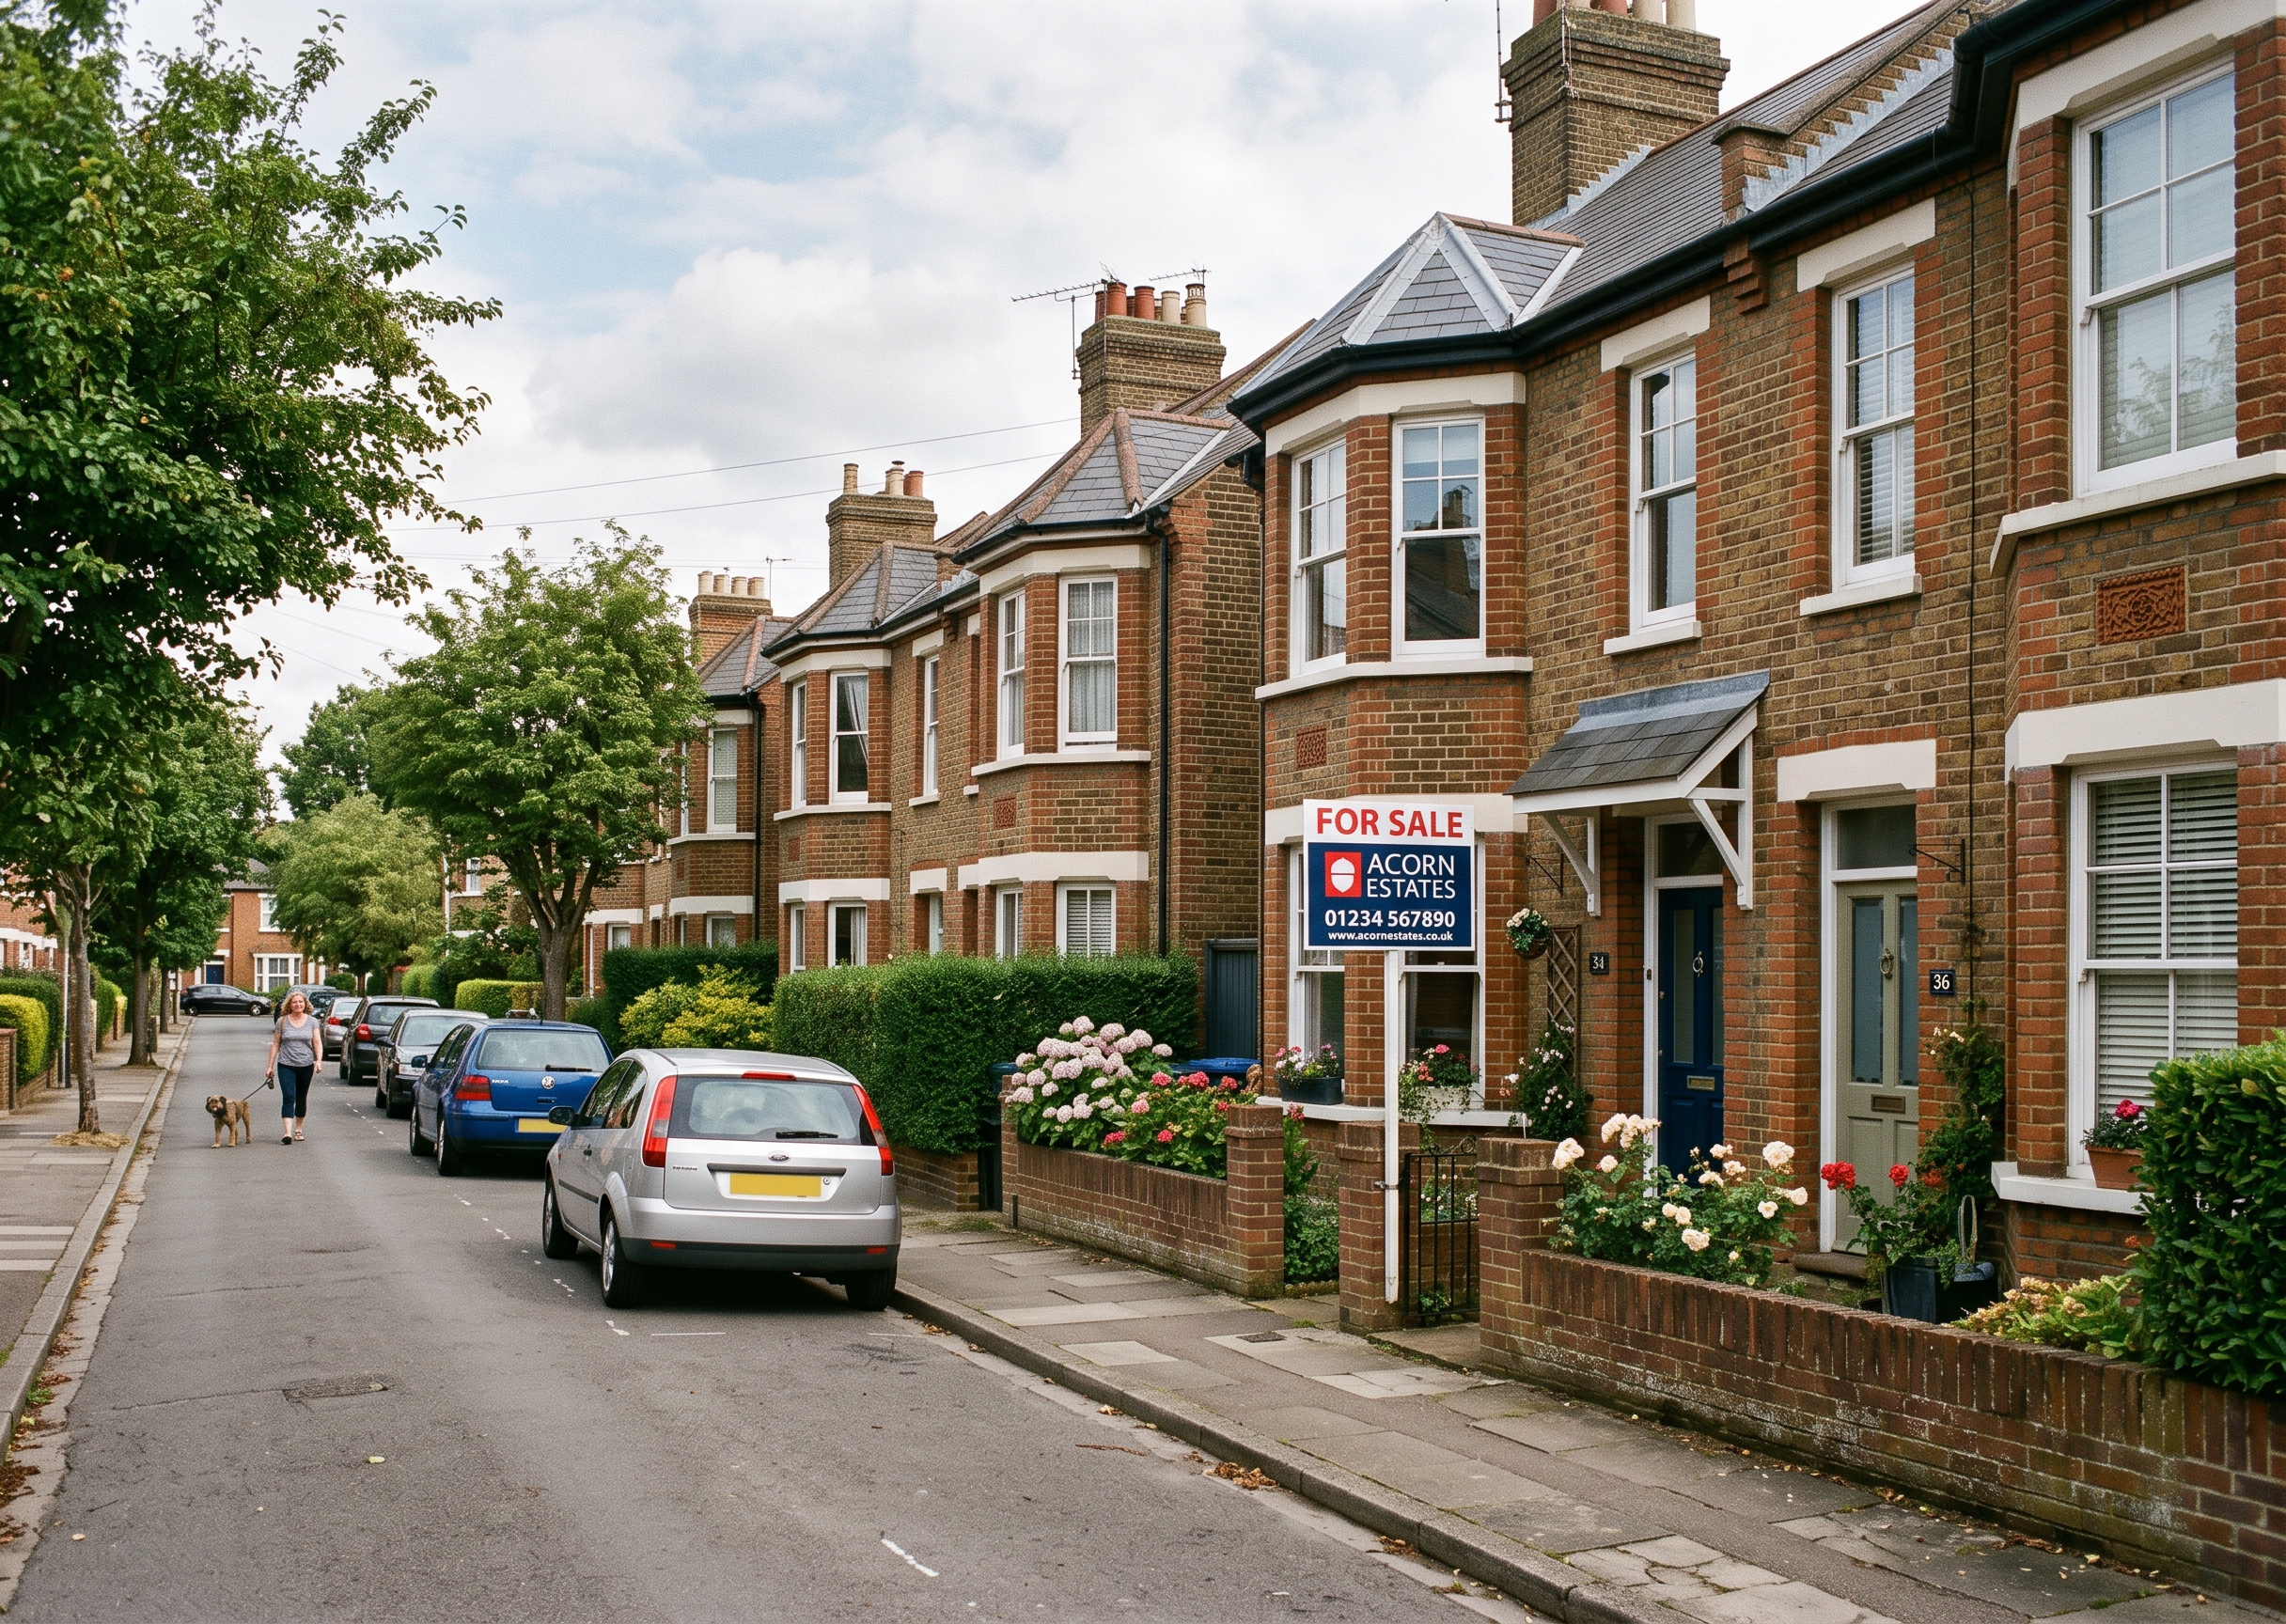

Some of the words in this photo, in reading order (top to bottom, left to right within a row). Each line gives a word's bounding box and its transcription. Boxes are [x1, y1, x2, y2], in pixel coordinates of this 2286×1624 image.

[1317, 807, 1380, 835] FOR
[1388, 809, 1464, 837] SALE
[1367, 852, 1455, 876] ACORN
[1367, 878, 1456, 899] ESTATES
[1324, 909, 1384, 928] 01234
[1387, 910, 1456, 928] 567890
[1327, 931, 1453, 941] www.acornestates.co.uk
[1934, 974, 1950, 990] 36
